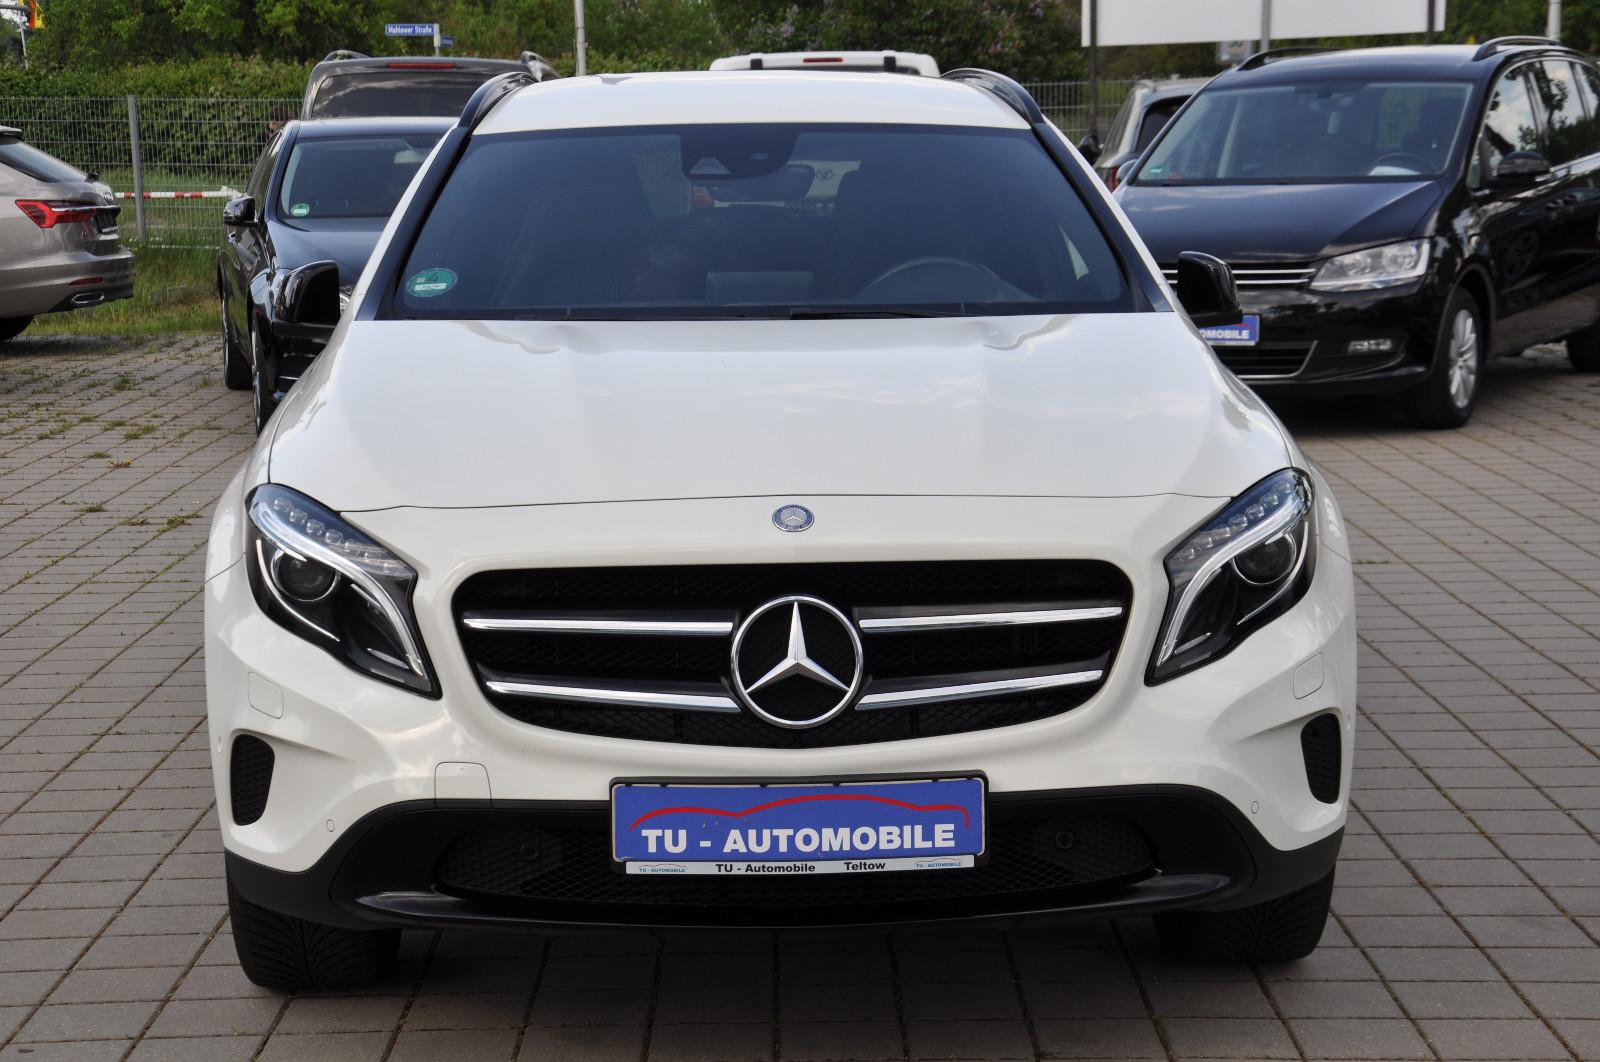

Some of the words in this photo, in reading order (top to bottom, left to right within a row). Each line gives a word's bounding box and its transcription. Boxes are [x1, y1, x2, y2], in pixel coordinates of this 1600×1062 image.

[415, 25, 432, 33] Straße
[1199, 329, 1250, 340] OMOBILE
[641, 829, 687, 853] TU
[722, 824, 955, 853] AUTOMOBILE
[715, 863, 733, 873] TU
[745, 862, 816, 873] Automobile
[844, 861, 886, 871] Teltow
